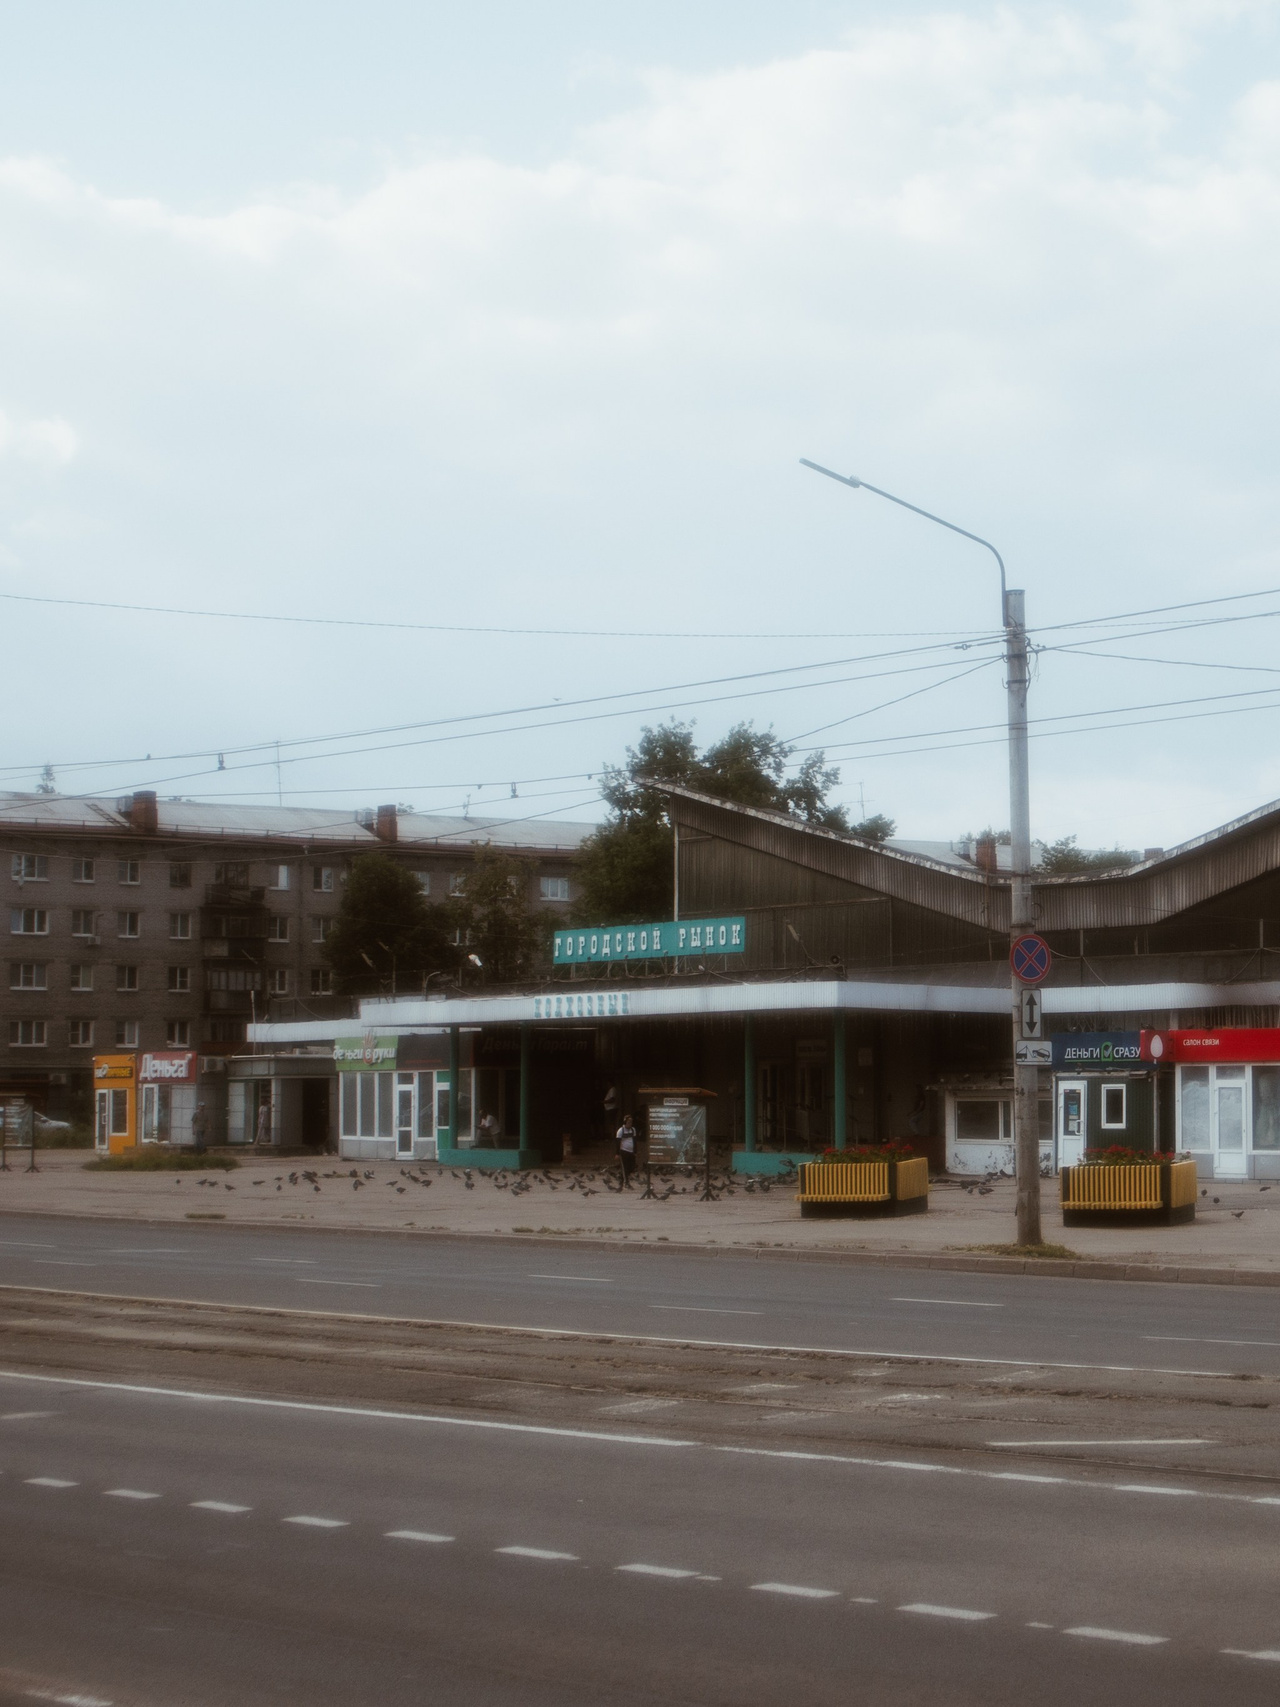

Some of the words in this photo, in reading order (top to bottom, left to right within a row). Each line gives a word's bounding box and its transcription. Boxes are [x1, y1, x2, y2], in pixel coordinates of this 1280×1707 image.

[554, 928, 661, 957] ГОРОДСКОЙ
[679, 924, 741, 948] РЫНОК
[1183, 1039, 1201, 1047] салон
[1202, 1038, 1220, 1046] связи
[333, 1045, 363, 1060] деньги
[372, 1047, 396, 1063] руки
[1064, 1047, 1100, 1059] ДЕНЬГИ
[1113, 1046, 1141, 1059] СРАЗУ
